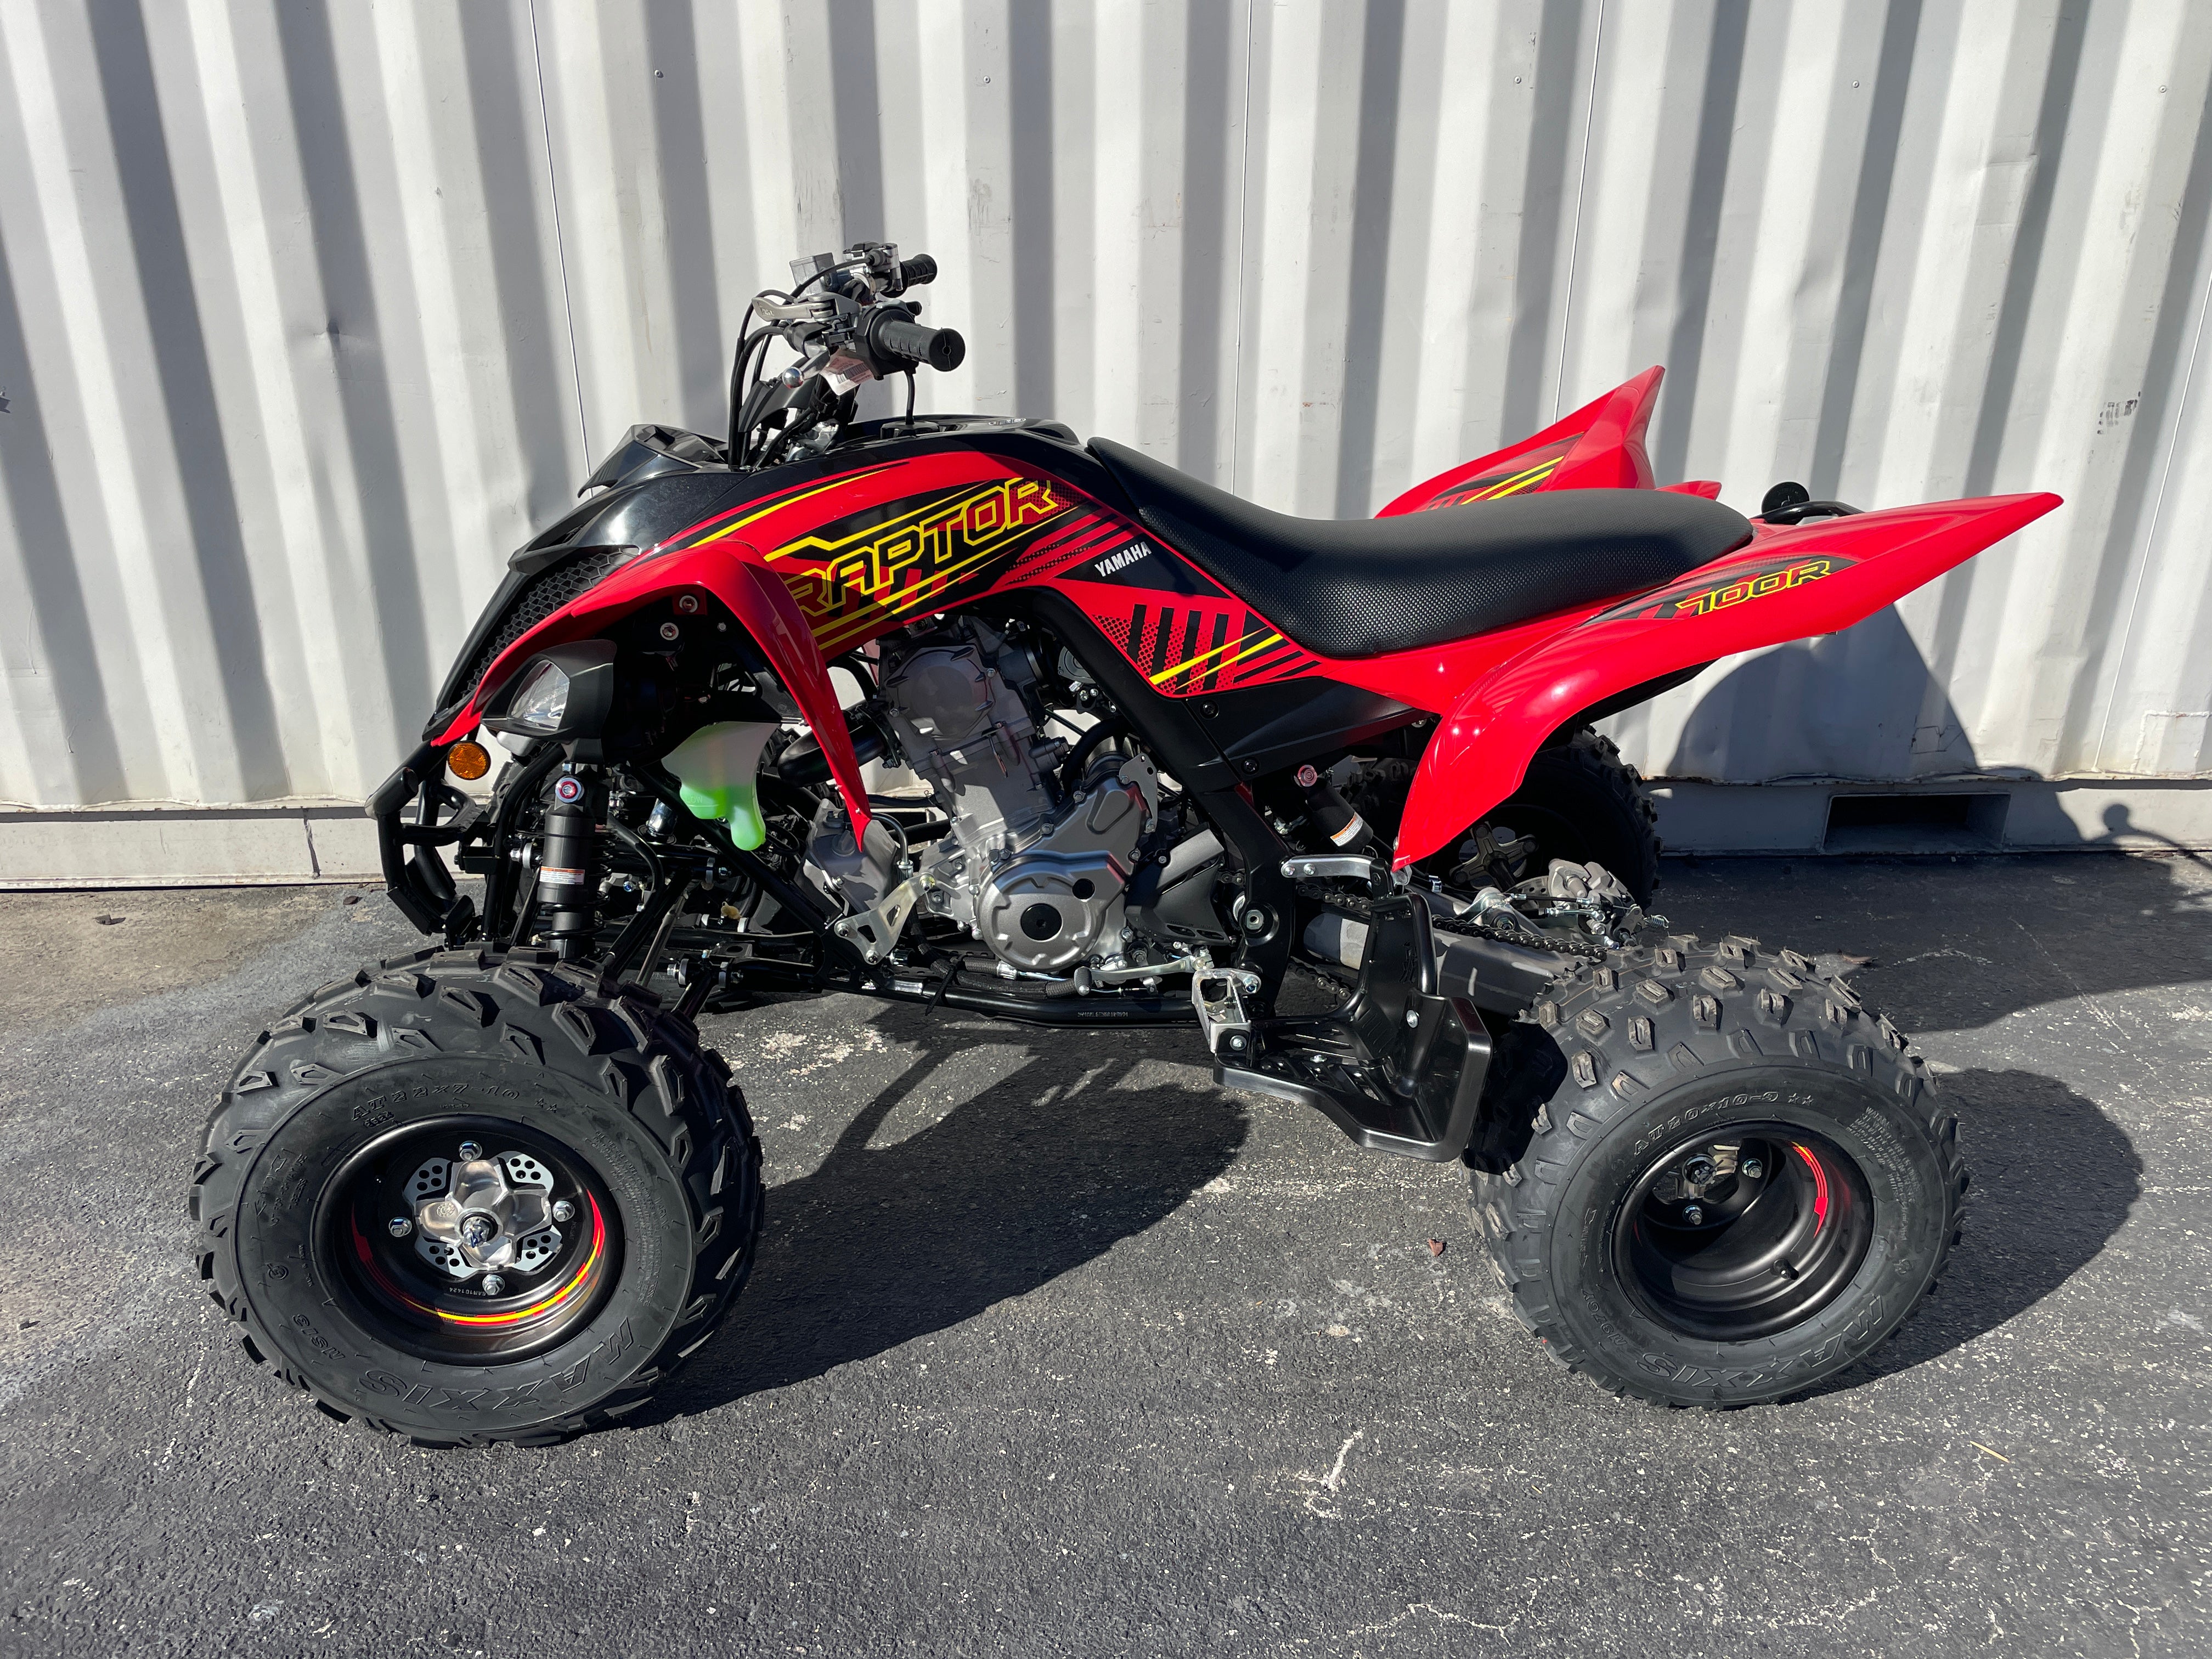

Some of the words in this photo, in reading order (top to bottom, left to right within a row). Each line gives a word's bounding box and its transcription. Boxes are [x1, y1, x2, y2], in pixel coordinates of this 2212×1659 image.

[783, 477, 1059, 617] RAPTOR
[1094, 541, 1152, 577] YAMAHA
[1675, 560, 1833, 615] 700R
[356, 1317, 635, 1410] MAXXIS
[1634, 1294, 1884, 1388] MAXXIS
